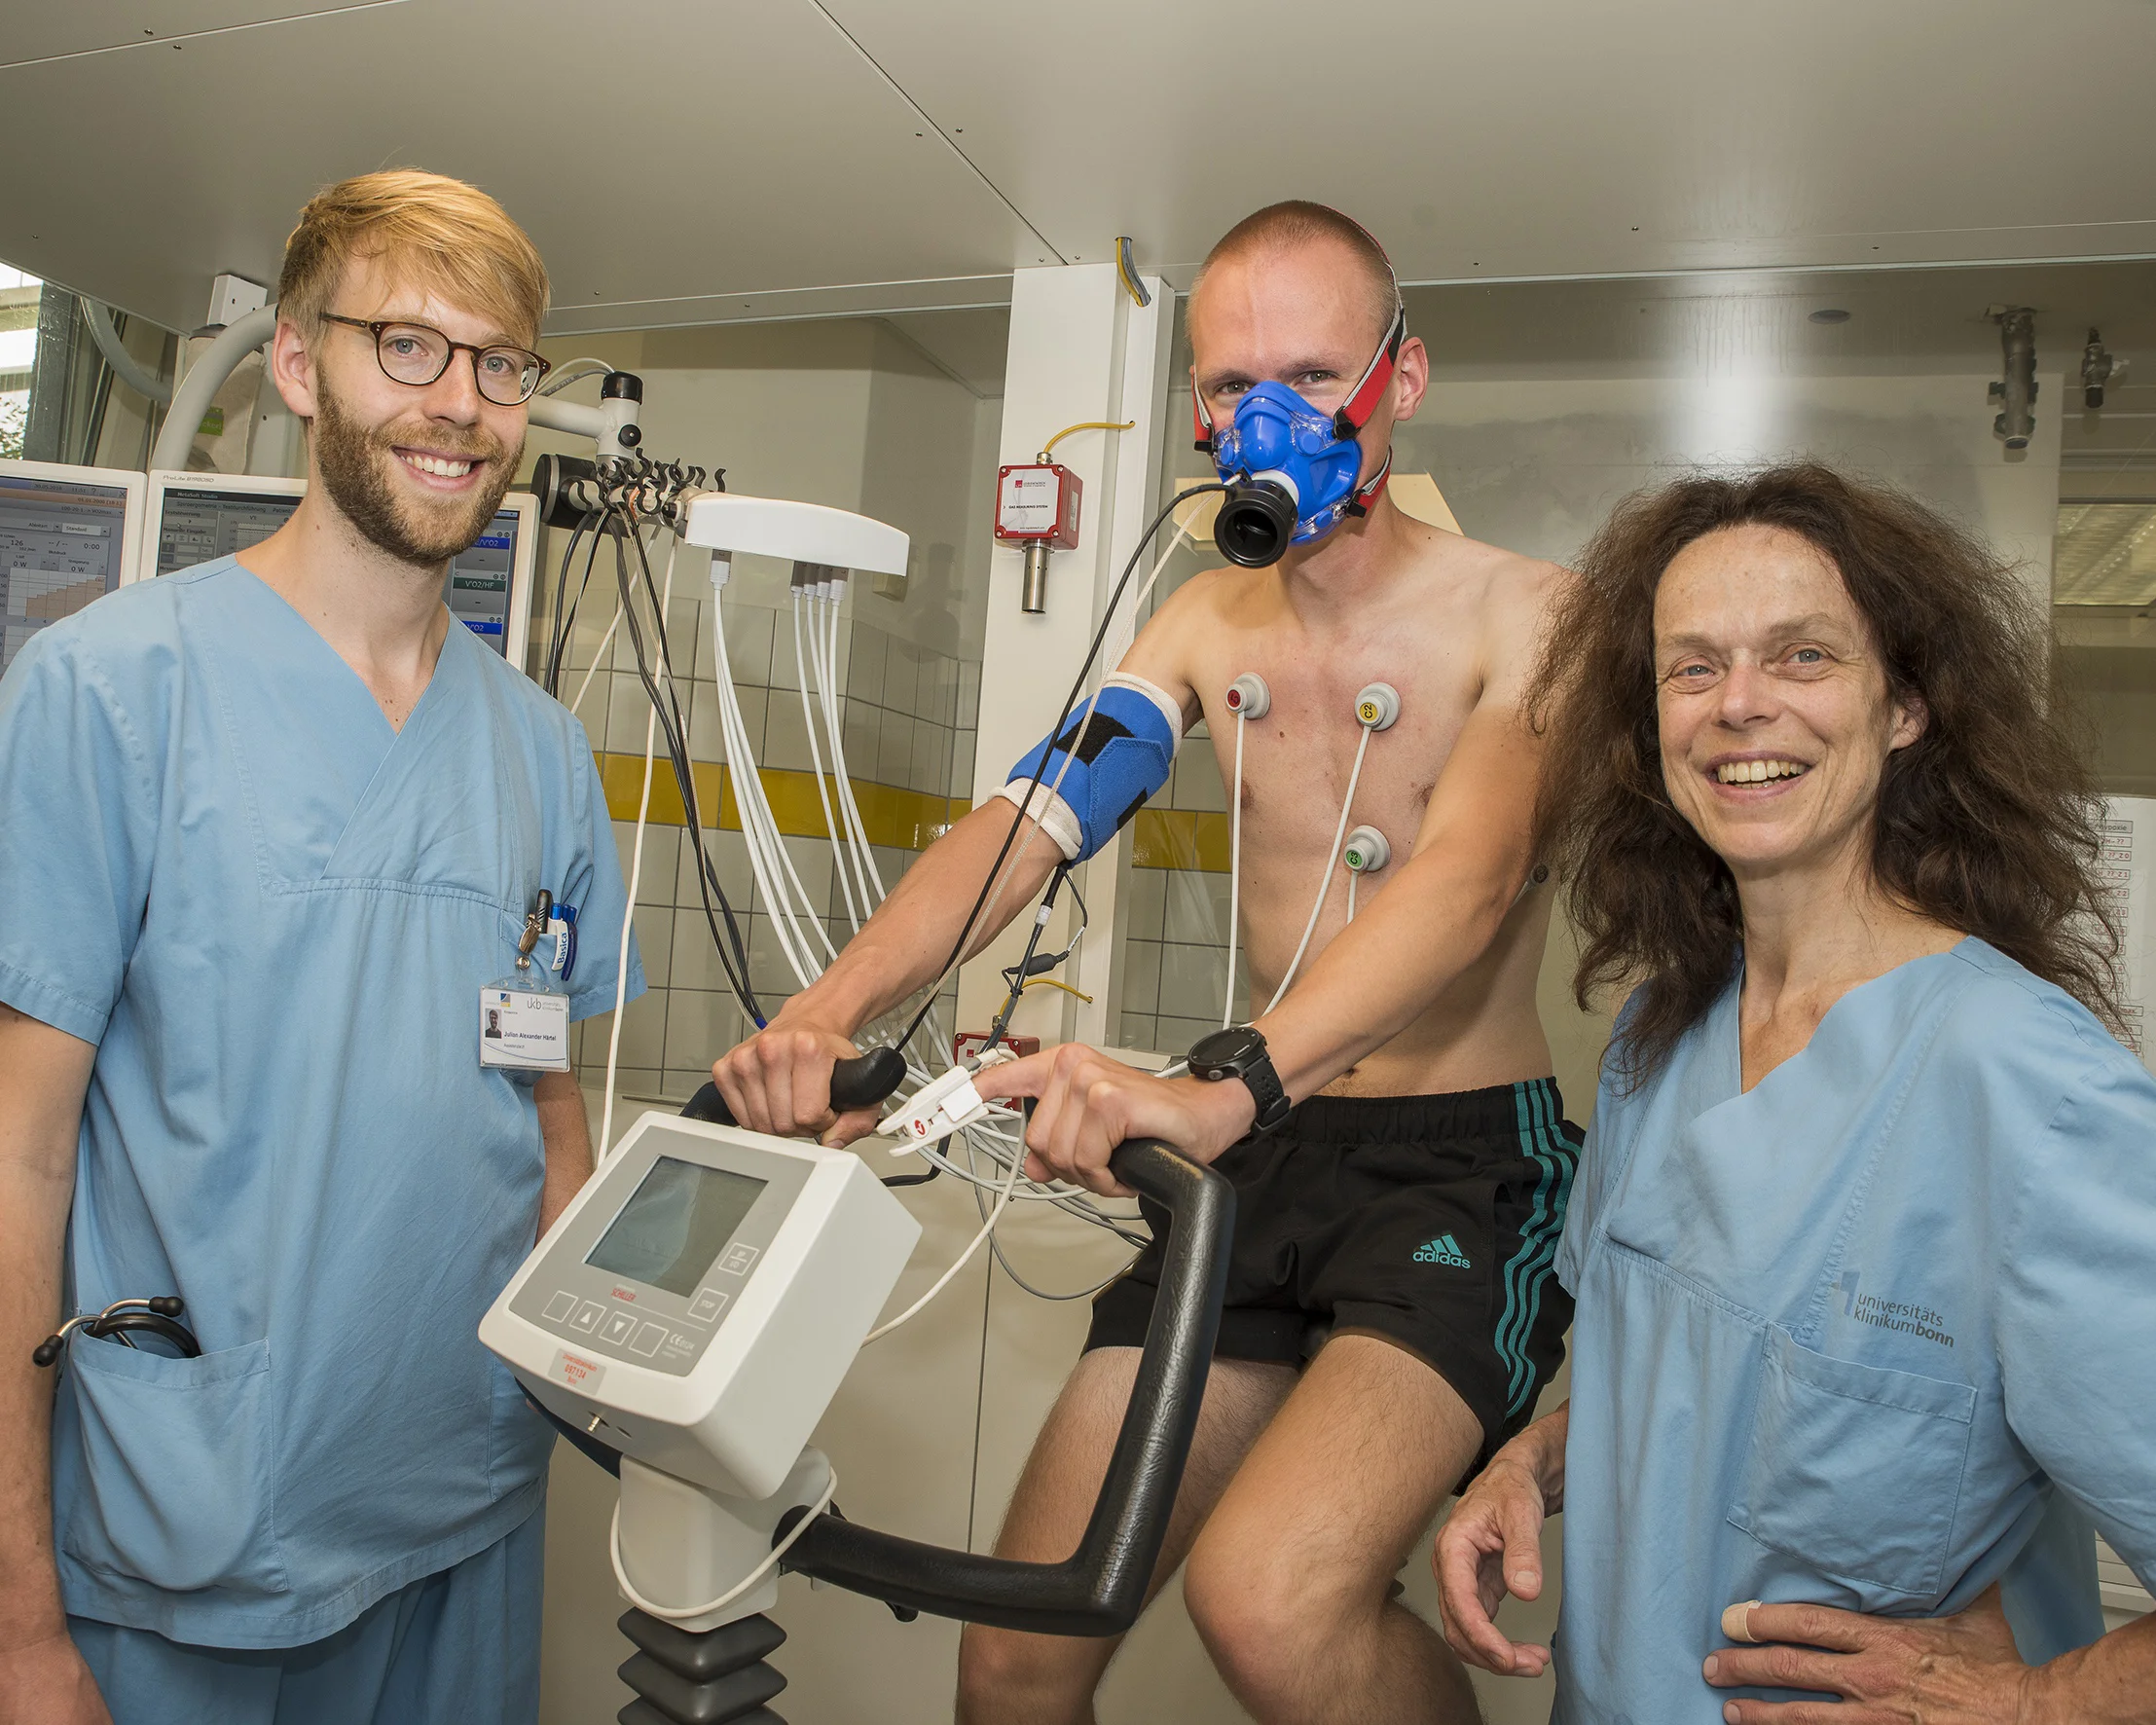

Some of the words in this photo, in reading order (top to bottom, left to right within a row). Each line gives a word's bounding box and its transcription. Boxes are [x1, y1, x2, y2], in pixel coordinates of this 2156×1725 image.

[1364, 704, 1372, 718] C2
[1350, 852, 1359, 864] C3
[557, 932, 567, 964] Basica
[1412, 1249, 1471, 1269] adidas
[611, 1288, 637, 1302] SCHILLER
[1857, 1293, 1944, 1327] universitäts
[1853, 1304, 1955, 1347] klinikumbonn
